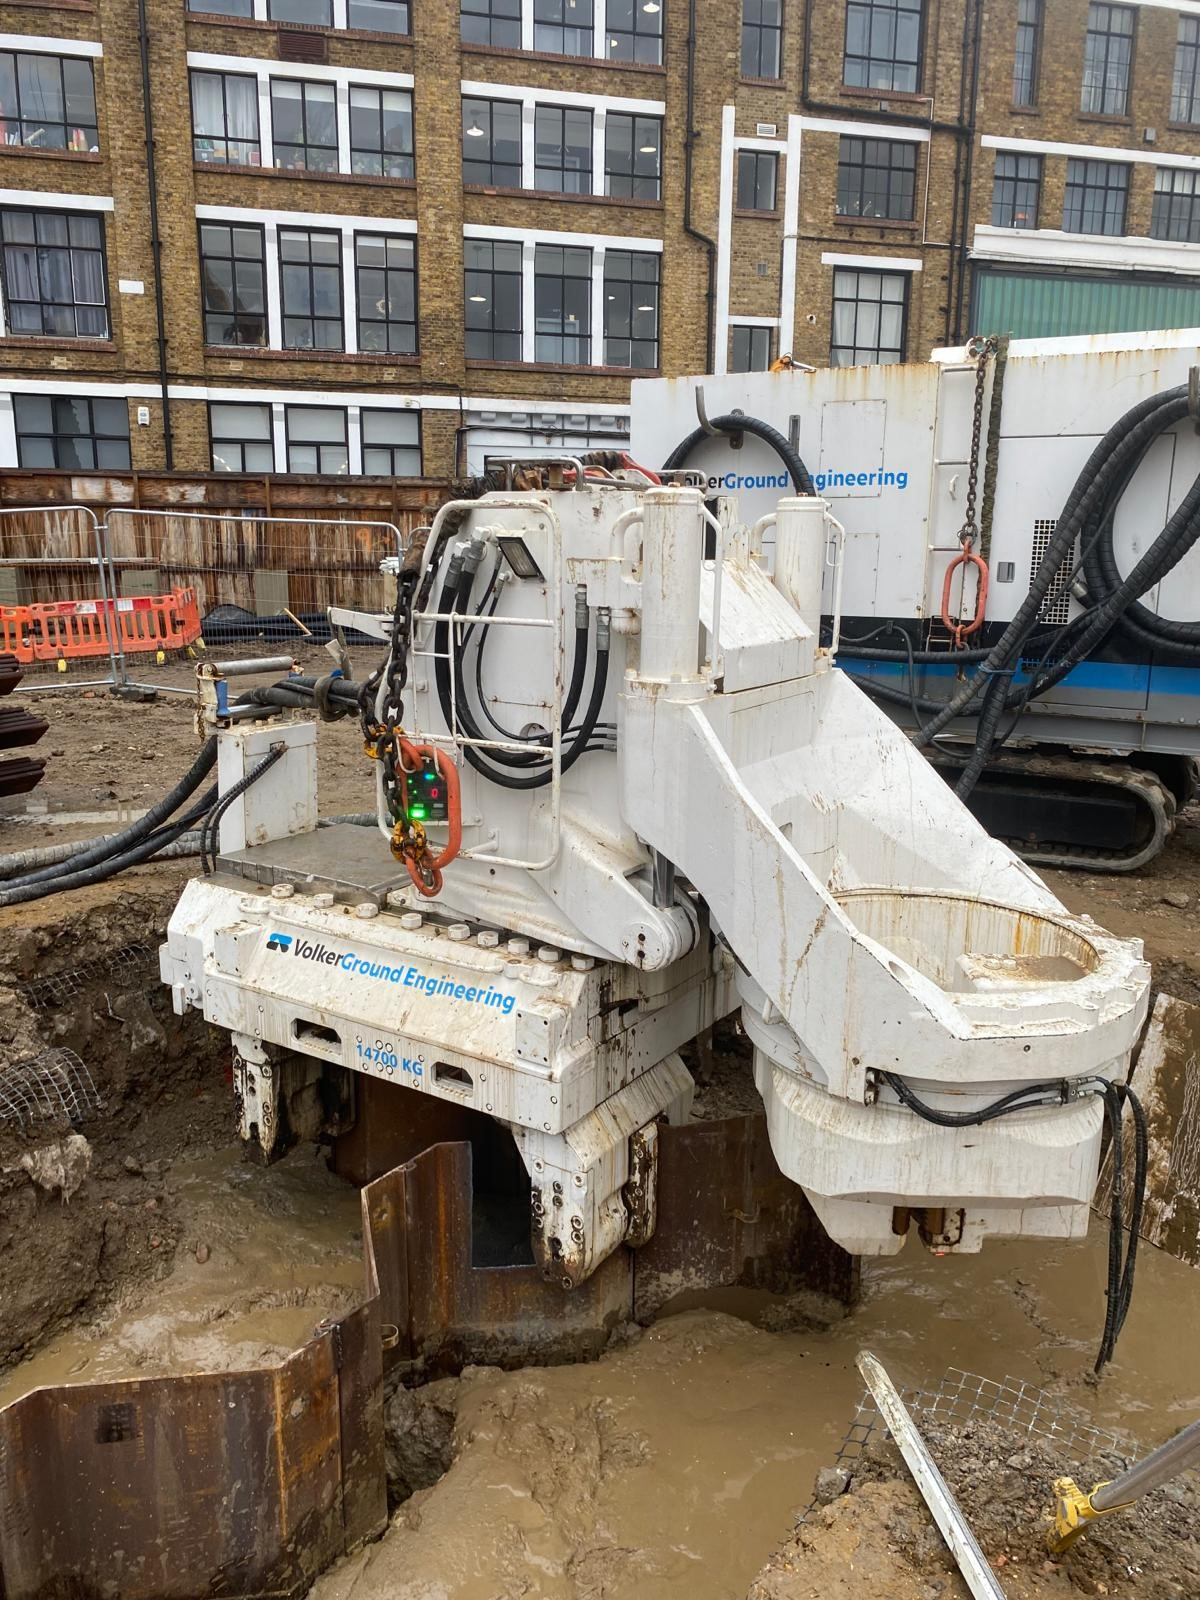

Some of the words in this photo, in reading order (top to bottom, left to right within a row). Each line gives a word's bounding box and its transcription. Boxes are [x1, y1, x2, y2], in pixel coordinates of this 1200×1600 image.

[808, 468, 908, 490] gineering
[294, 938, 404, 983] VolkerGround
[403, 967, 516, 1014] Engineering
[356, 1044, 398, 1067] 14700
[402, 1058, 423, 1076] KG
